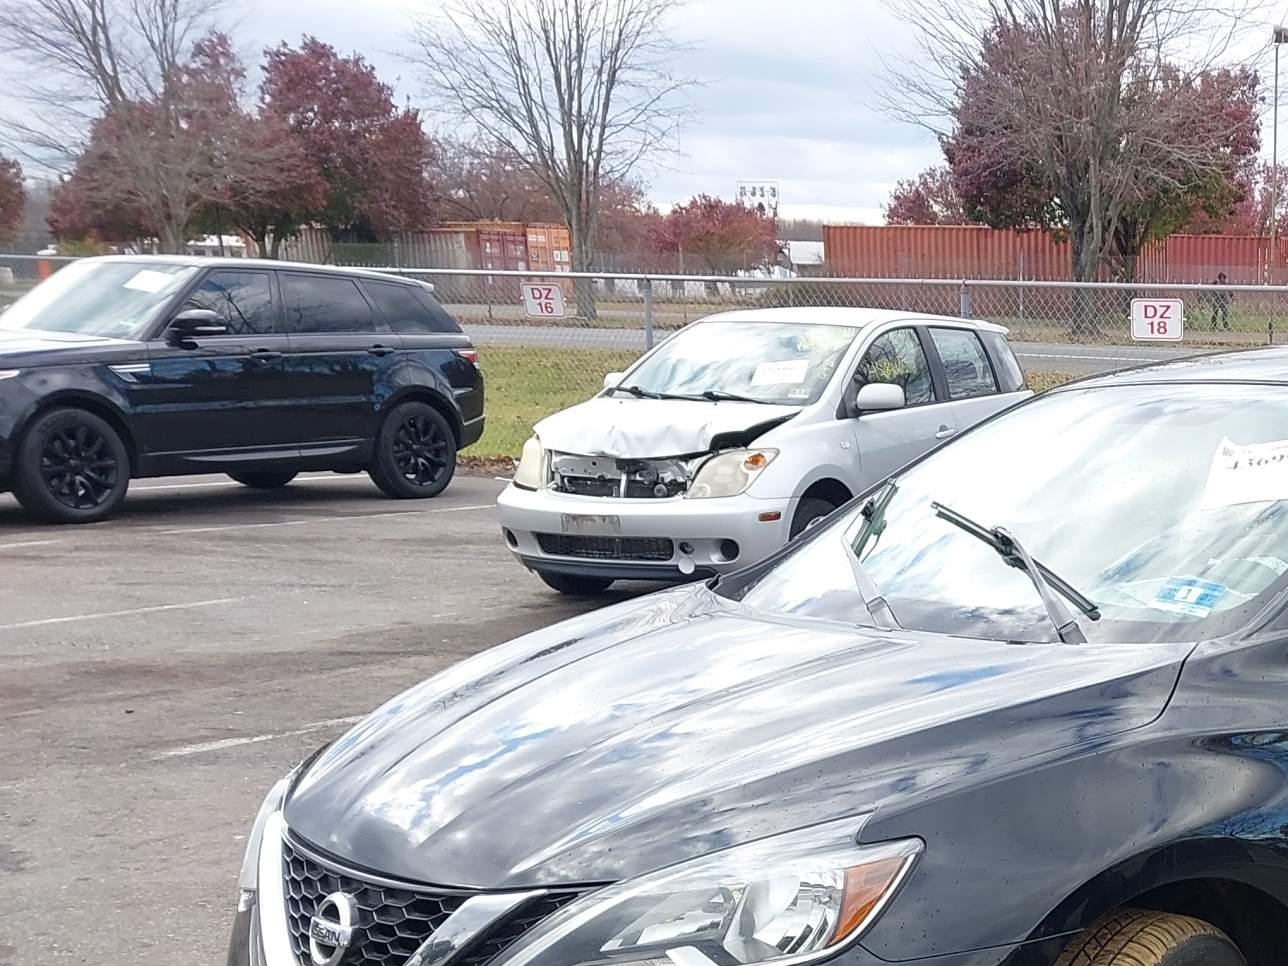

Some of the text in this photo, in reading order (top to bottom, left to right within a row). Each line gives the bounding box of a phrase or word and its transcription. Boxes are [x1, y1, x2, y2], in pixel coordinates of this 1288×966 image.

[531, 288, 554, 300] DZ
[537, 302, 554, 314] 16
[1144, 305, 1172, 319] DZ
[1147, 321, 1168, 335] 18
